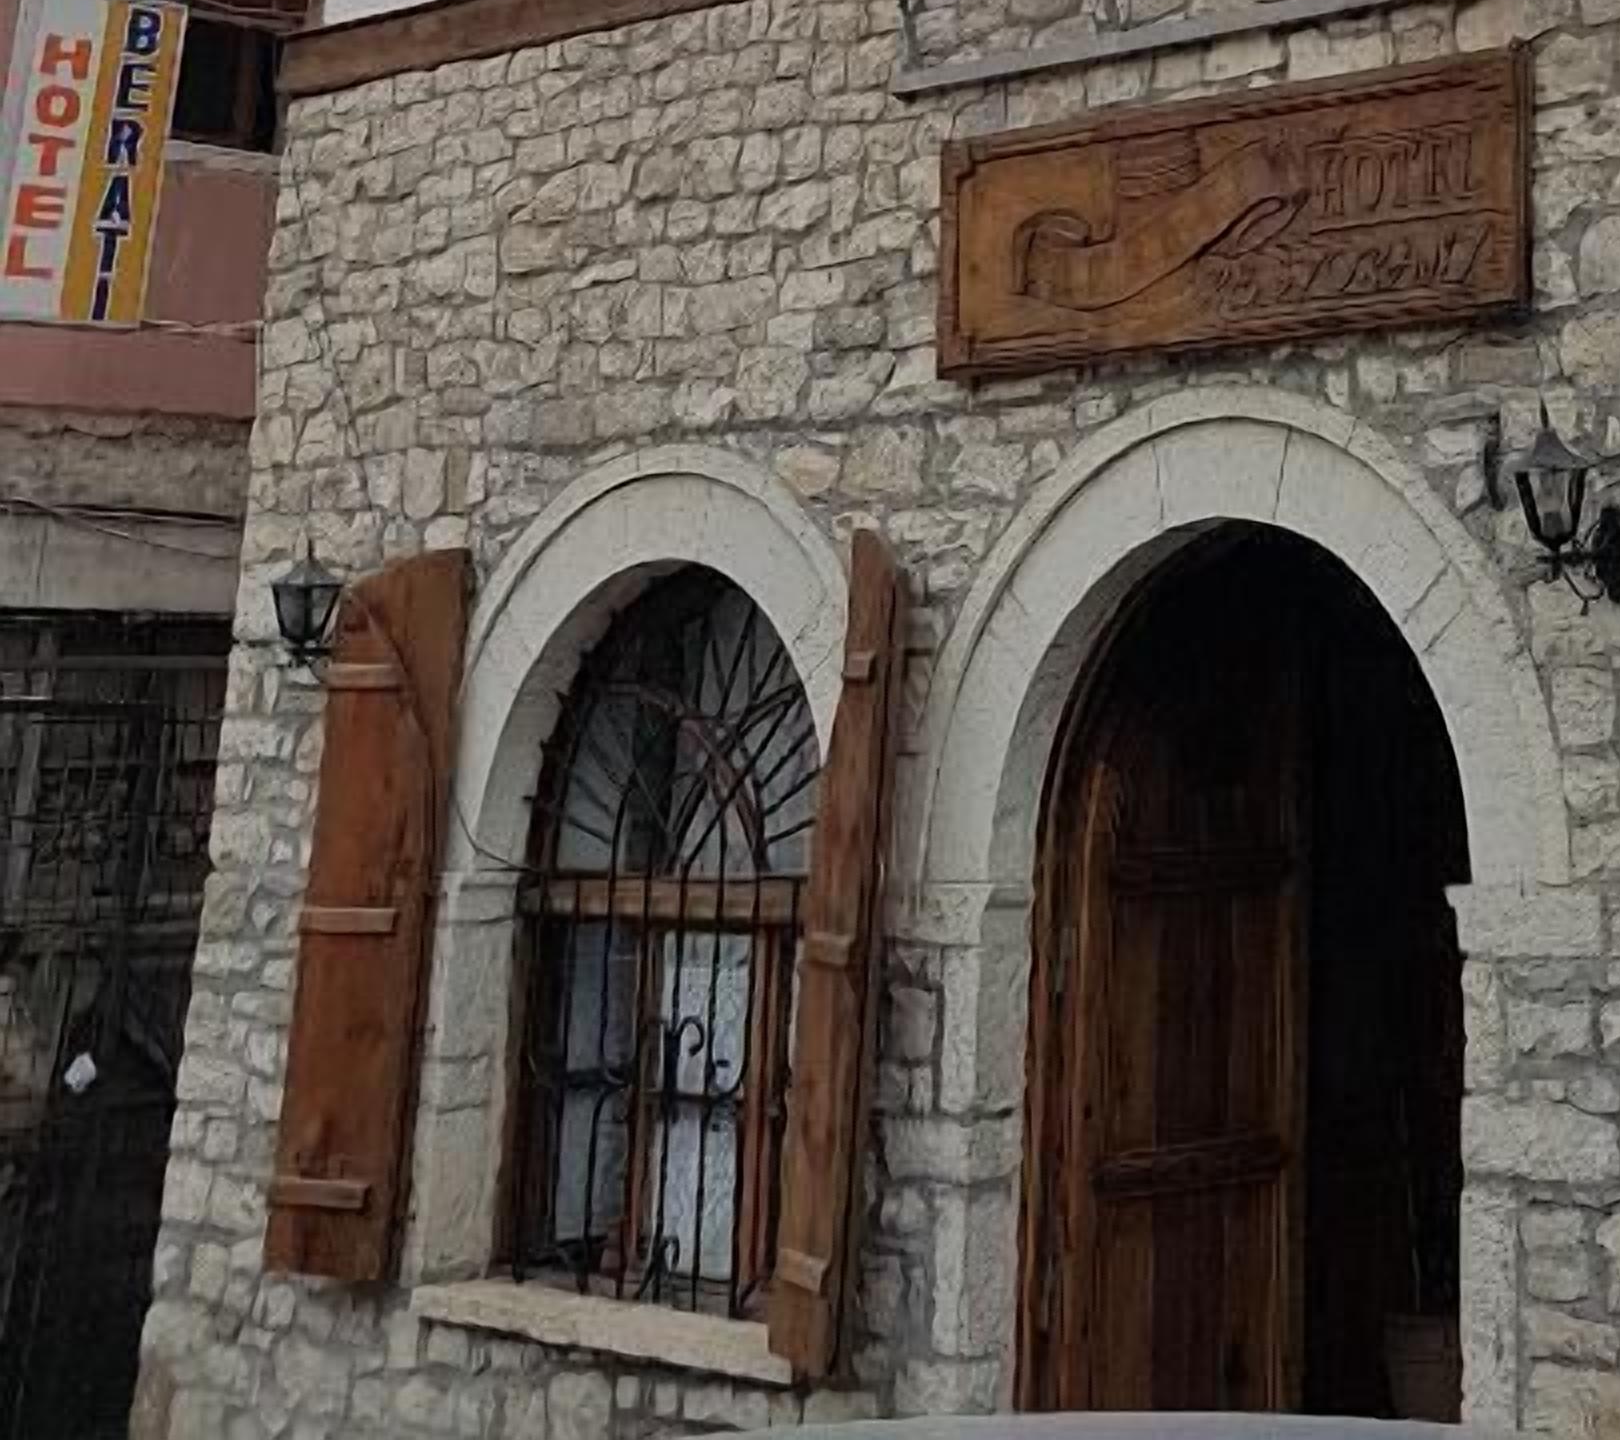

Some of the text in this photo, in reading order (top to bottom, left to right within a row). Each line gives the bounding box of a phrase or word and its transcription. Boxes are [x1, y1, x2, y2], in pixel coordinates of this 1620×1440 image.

[4, 31, 92, 280] HOTEL
[91, 5, 162, 321] BERATI
[1304, 128, 1484, 218] HOTEL
